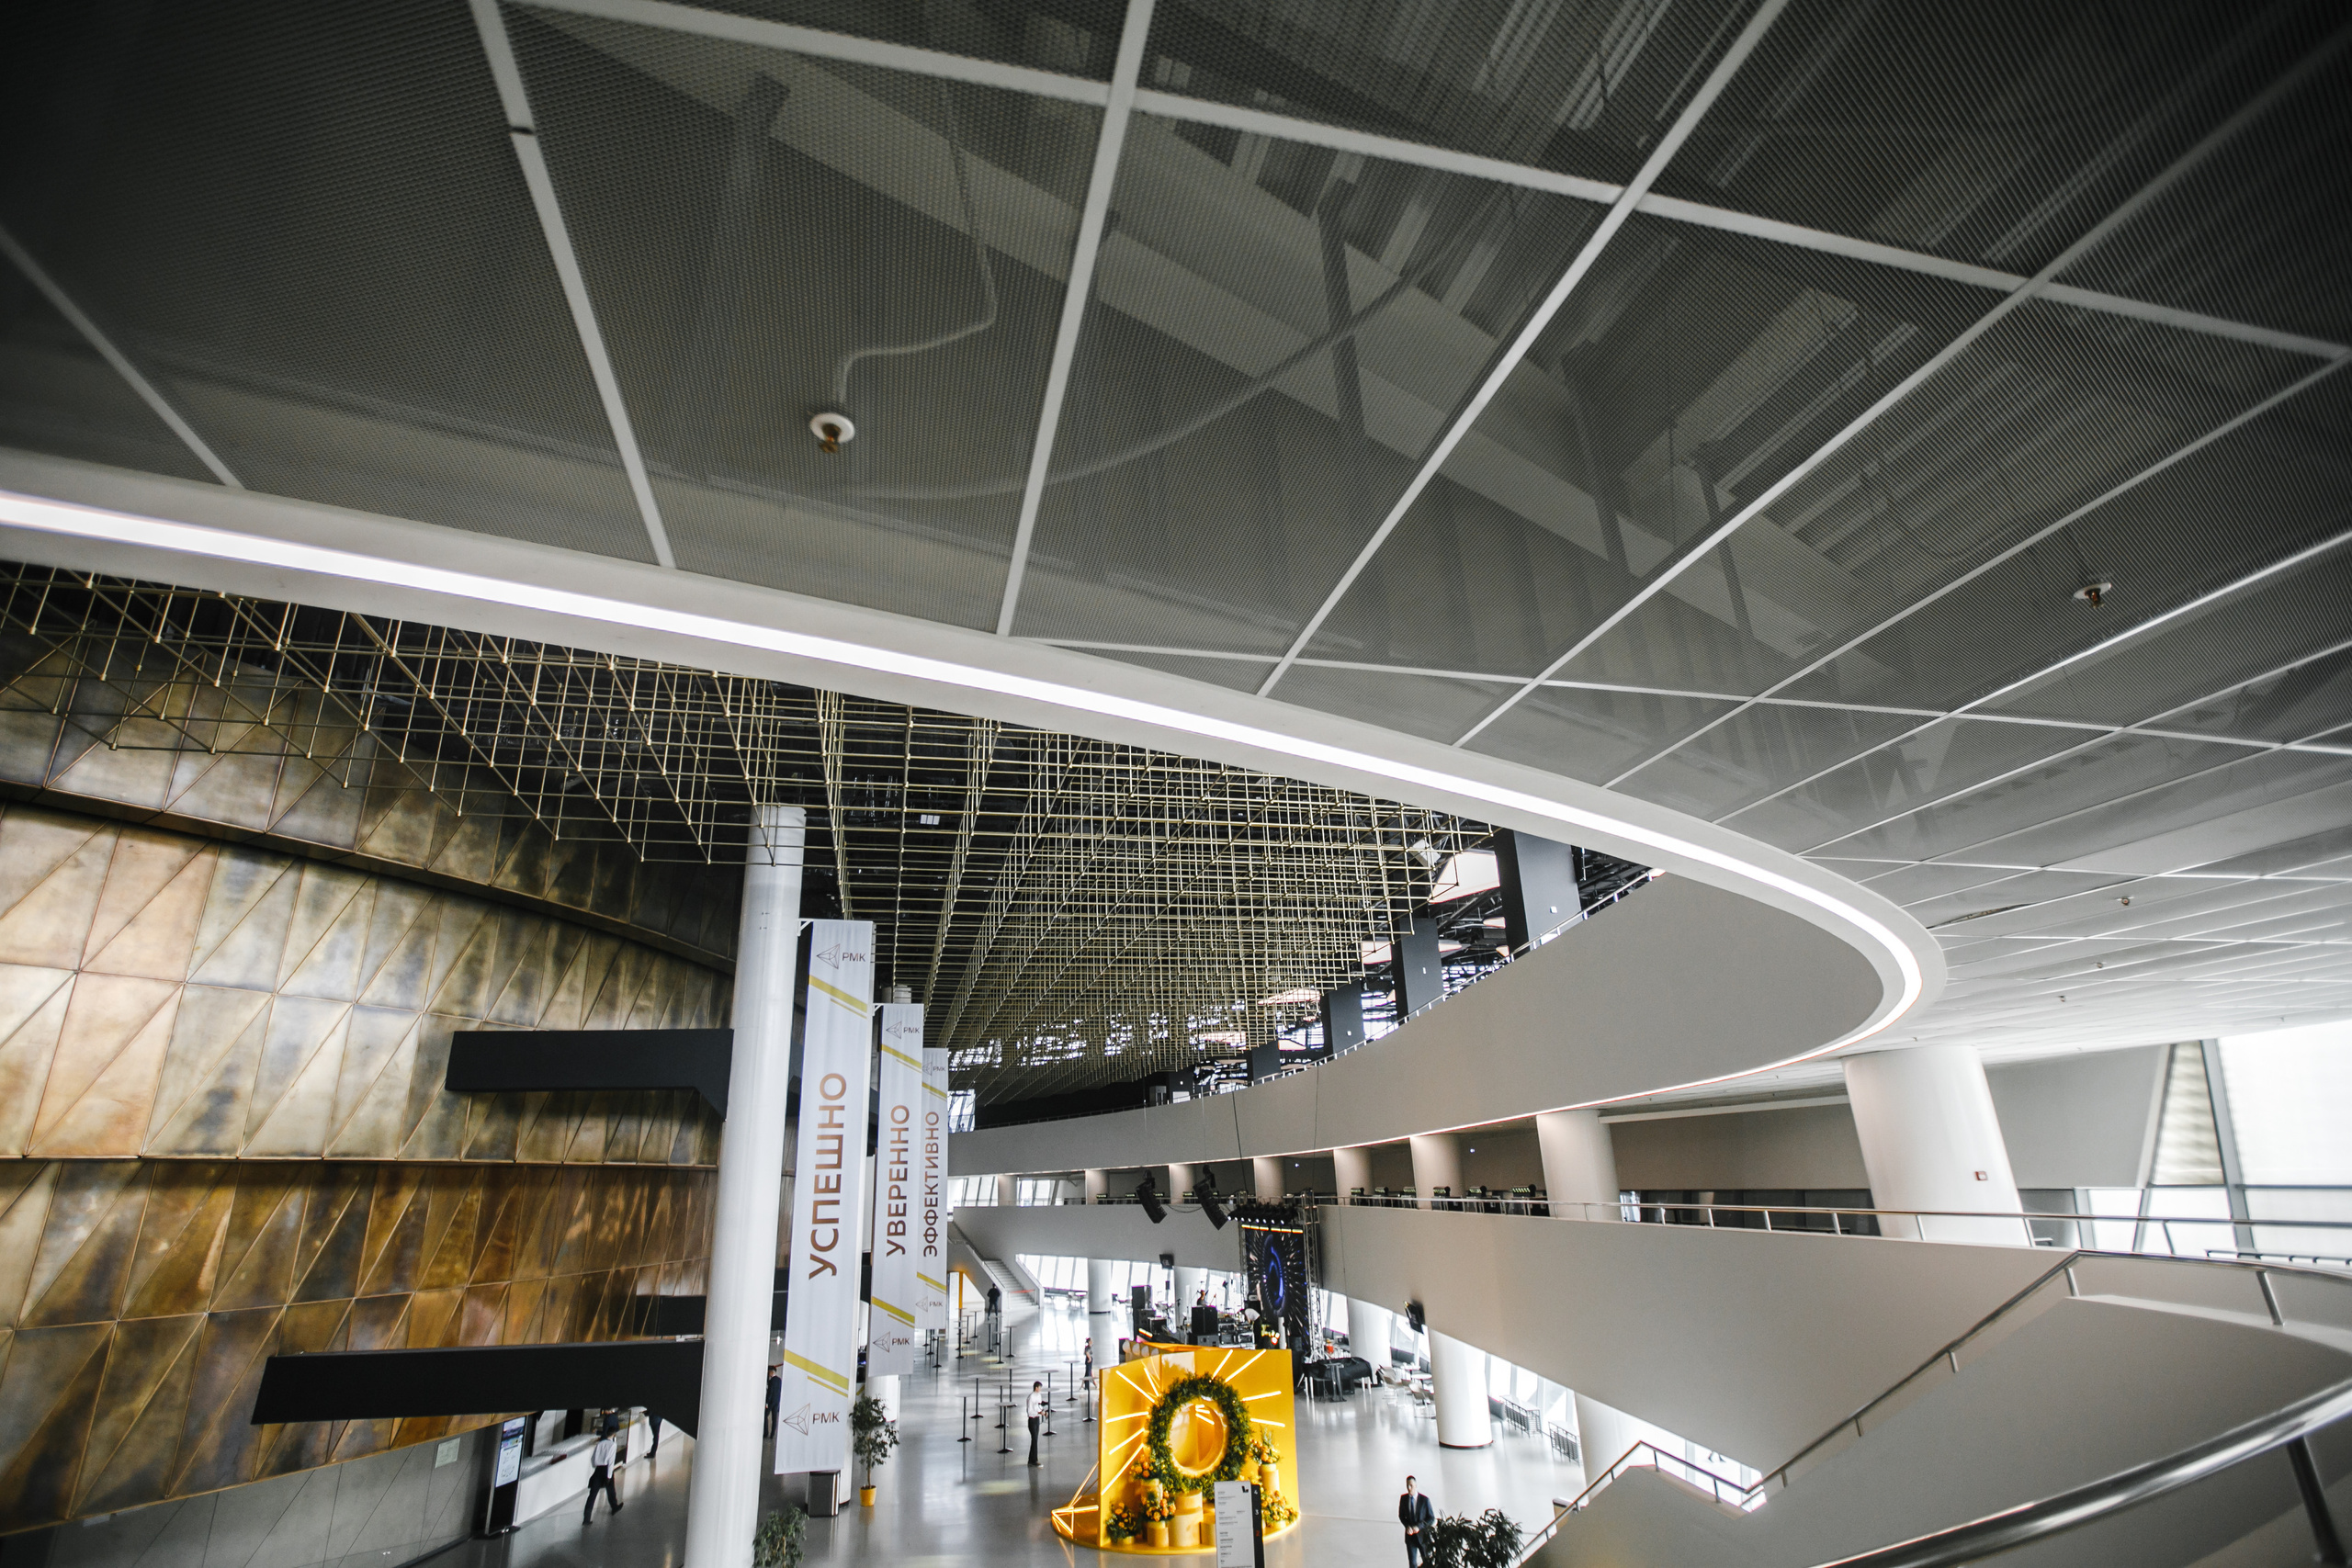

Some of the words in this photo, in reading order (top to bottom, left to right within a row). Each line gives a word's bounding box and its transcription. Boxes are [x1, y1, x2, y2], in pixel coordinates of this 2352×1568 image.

[842, 953, 866, 963] РМК
[808, 1073, 847, 1280] УСПЕШНО
[886, 1105, 910, 1258] УВЕРЕННО
[923, 1111, 940, 1258] ЭФФЕКТИВНО
[891, 1337, 910, 1346] РМК
[812, 1412, 840, 1425] РМК
